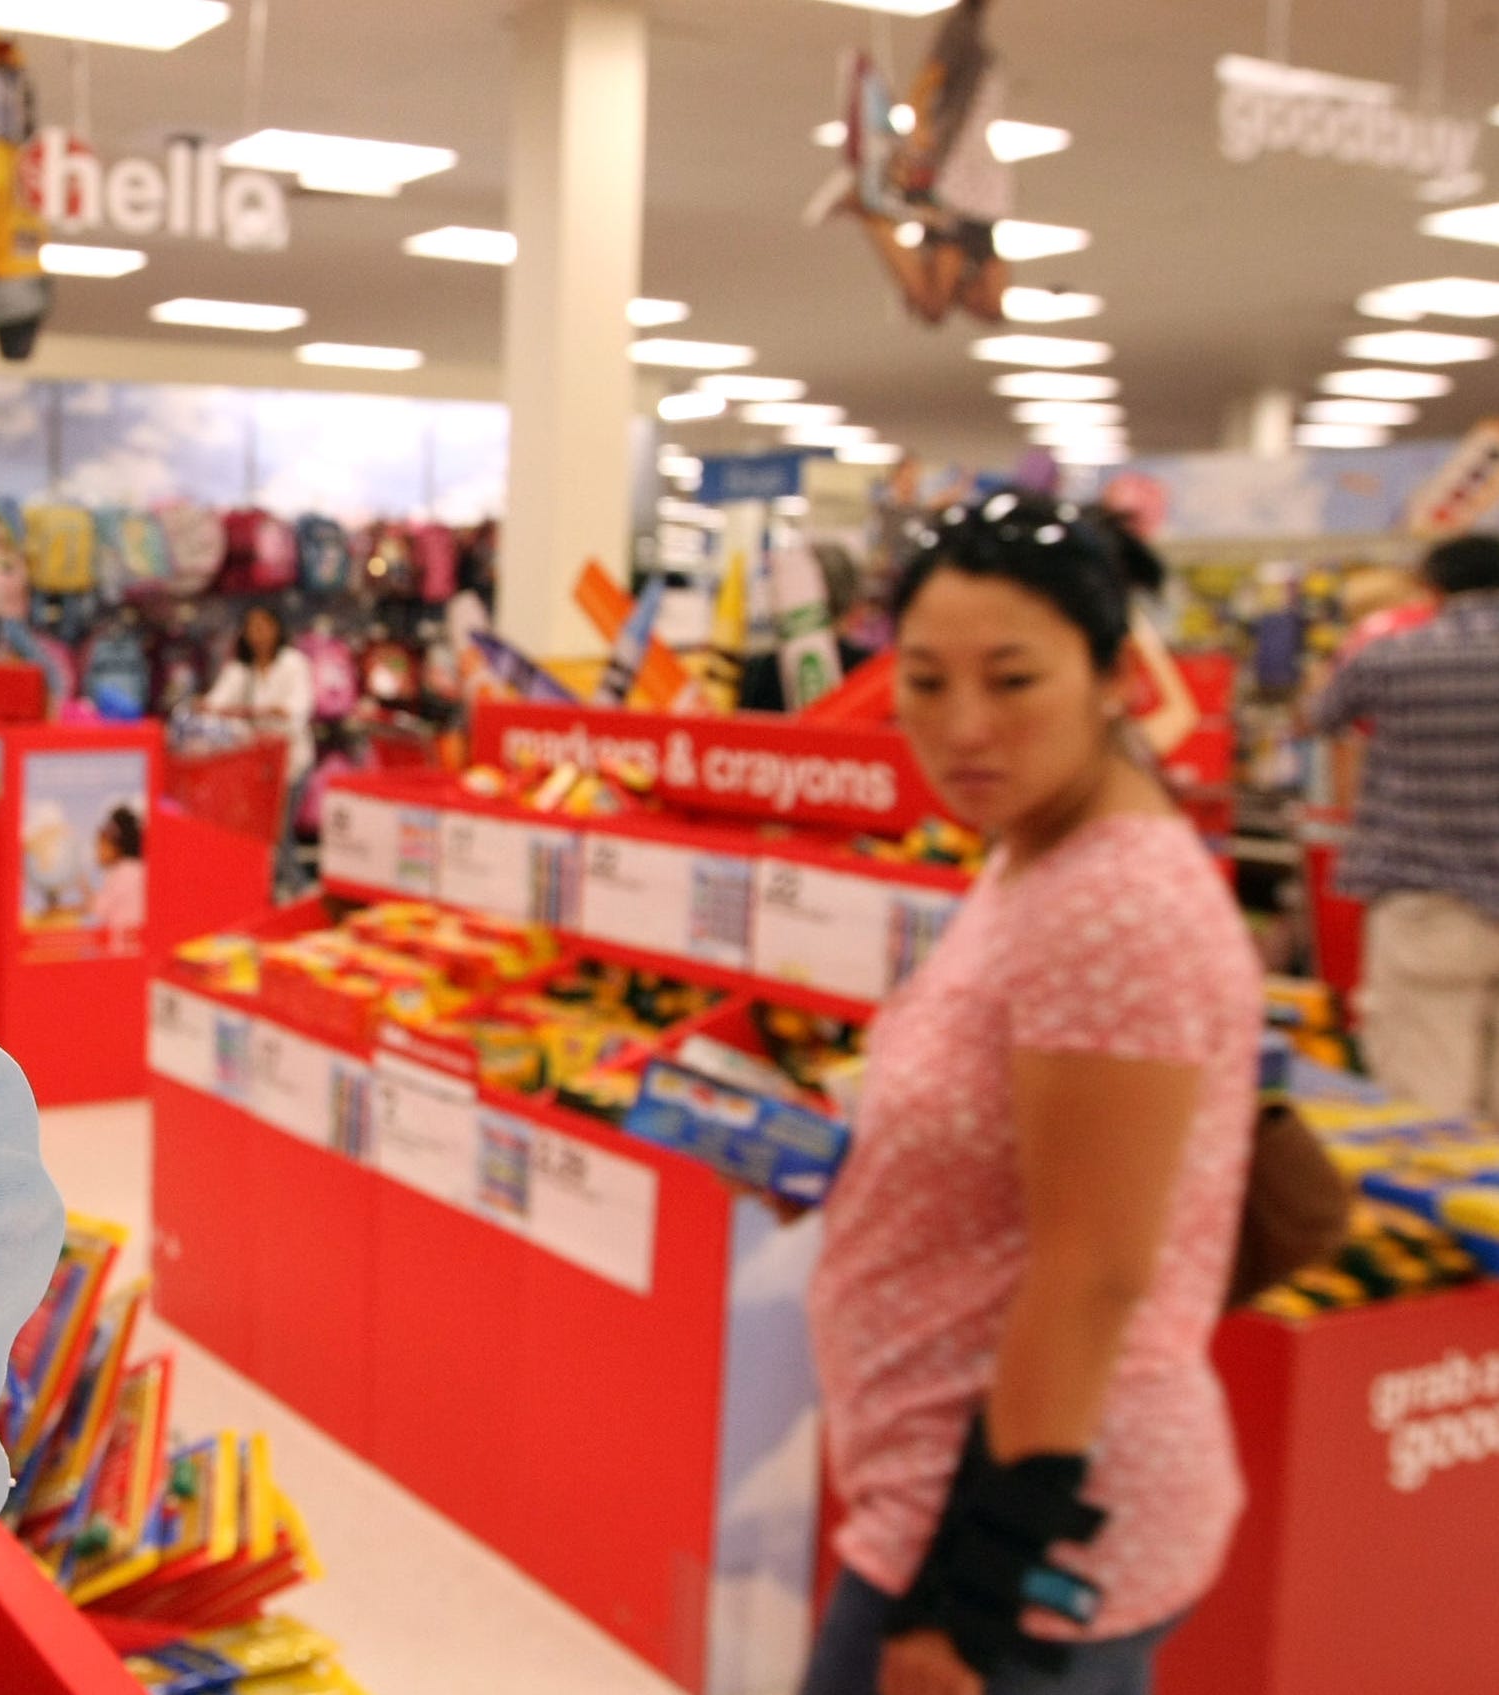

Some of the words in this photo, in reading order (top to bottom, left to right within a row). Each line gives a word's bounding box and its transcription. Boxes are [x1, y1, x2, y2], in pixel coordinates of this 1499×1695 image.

[40, 124, 290, 250] hello
[663, 729, 697, 788] &
[701, 747, 897, 812] crayons
[1389, 1405, 1499, 1493] goo
